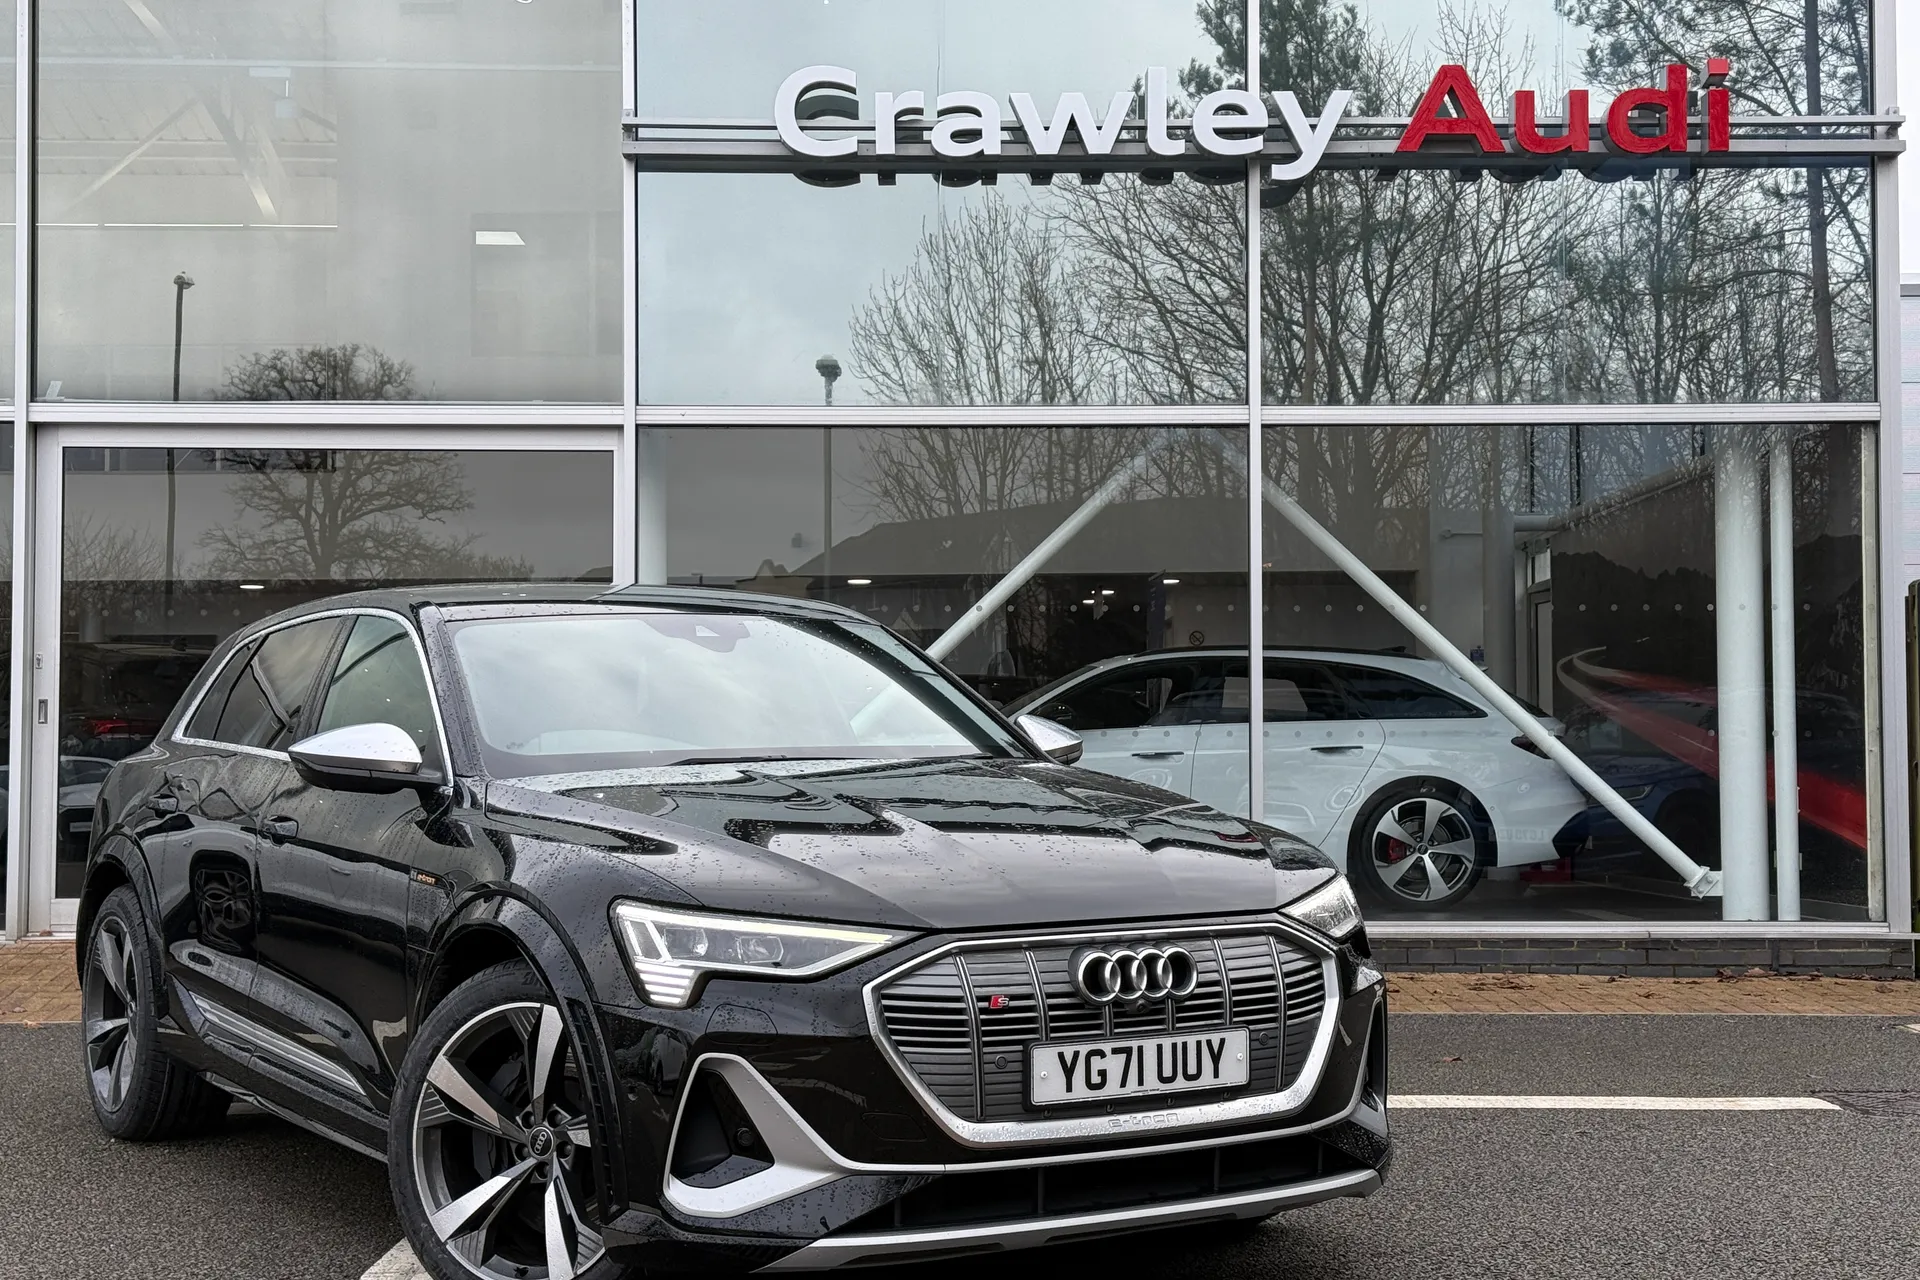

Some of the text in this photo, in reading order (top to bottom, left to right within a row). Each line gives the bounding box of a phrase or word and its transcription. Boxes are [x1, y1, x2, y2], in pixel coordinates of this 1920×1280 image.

[773, 58, 1730, 182] Crawley Audi
[1057, 1036, 1226, 1093] YG71 UUY
[1107, 1112, 1180, 1128] e-tron
